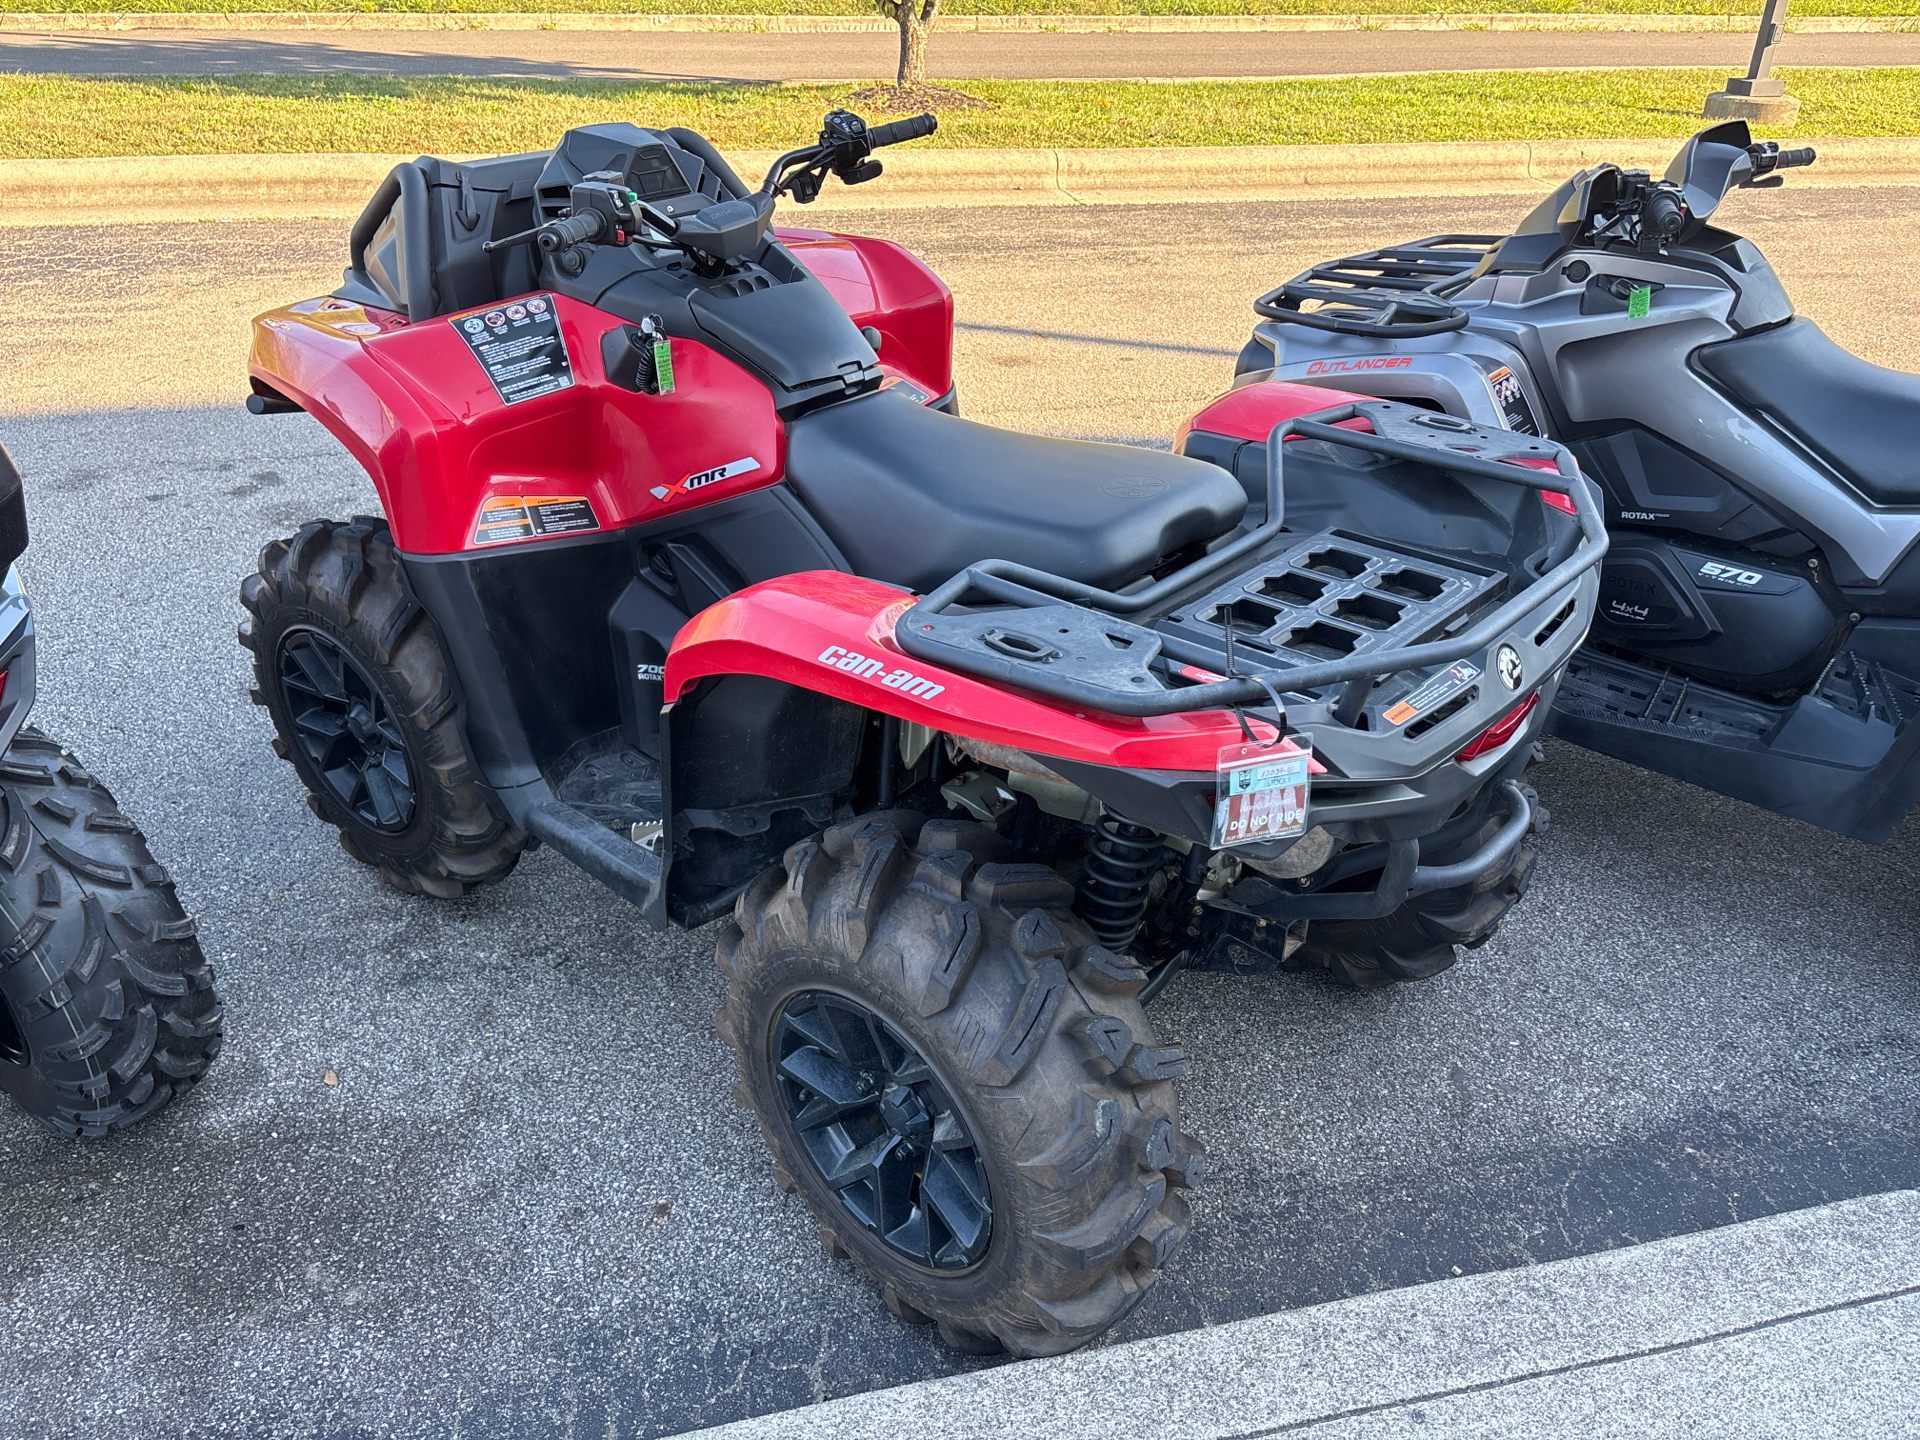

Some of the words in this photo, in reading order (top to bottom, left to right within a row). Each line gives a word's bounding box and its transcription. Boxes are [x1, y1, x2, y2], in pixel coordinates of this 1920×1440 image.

[1306, 357, 1413, 375] OUTLANDER
[1621, 511, 1655, 520] ROTAX
[1699, 561, 1763, 585] 570
[1611, 600, 1649, 616] 4x4
[637, 673, 662, 681] ROTAX
[817, 645, 946, 700] can-am
[1266, 777, 1286, 788] STOCK
[1230, 819, 1247, 831] DO
[1250, 814, 1274, 827] NOT
[1275, 809, 1301, 822] RIDE
